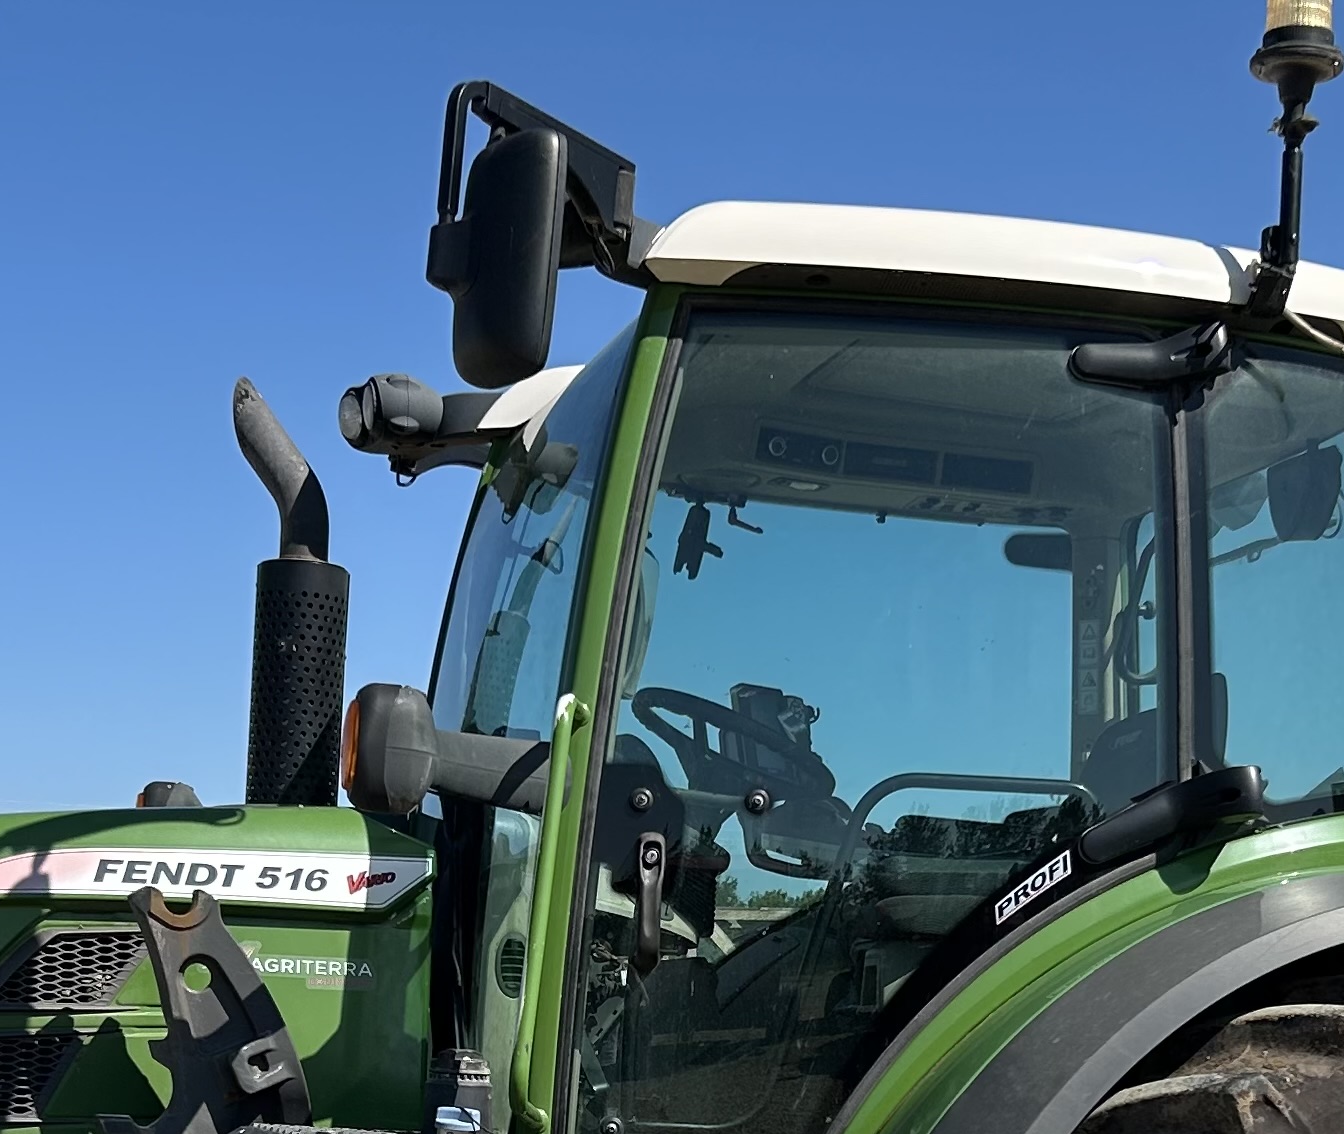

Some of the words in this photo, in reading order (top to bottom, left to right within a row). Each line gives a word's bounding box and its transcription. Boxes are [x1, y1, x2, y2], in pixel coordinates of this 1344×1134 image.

[93, 859, 244, 889] FENDT
[256, 866, 330, 892] 516
[997, 854, 1068, 919] PROFI
[251, 958, 374, 978] AGRITERRA
